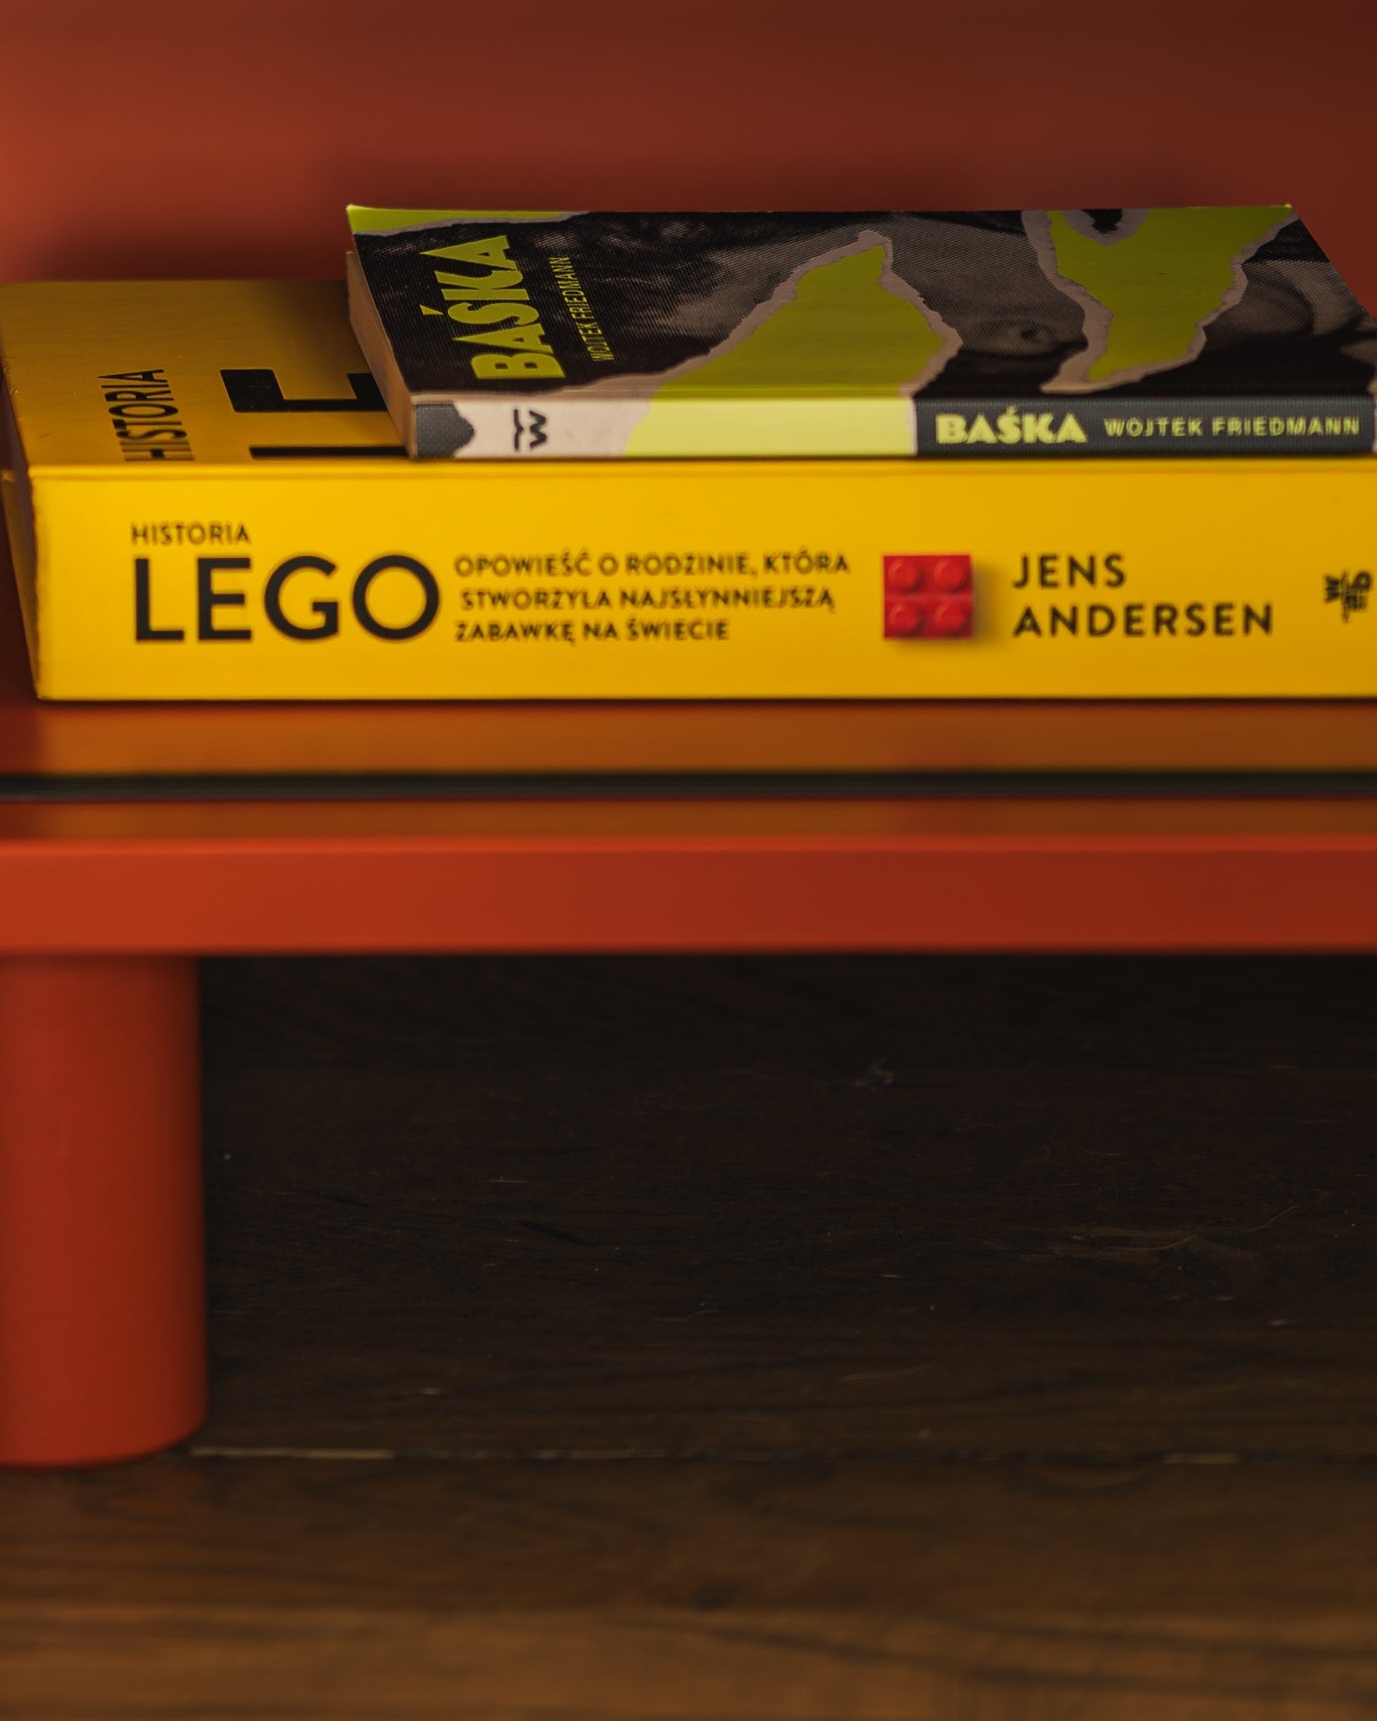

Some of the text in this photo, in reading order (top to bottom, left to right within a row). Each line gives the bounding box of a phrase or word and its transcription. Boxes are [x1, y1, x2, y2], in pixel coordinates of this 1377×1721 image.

[548, 255, 597, 321] FRIEDMANN
[419, 235, 566, 380] BAŚKA
[97, 368, 196, 462] HISTORIA
[935, 405, 1361, 446] BAŚKA WOJTEK FRIEDMANN
[130, 522, 251, 546] HISTORIA
[453, 545, 850, 579] OPOWIEŚĆ O RODZINIE, KTÓRA
[1012, 552, 1127, 590] JENS
[134, 554, 441, 642] LEGO
[459, 585, 837, 614] STWORZYŁA NAJSŁYNNIEJSZĄ
[454, 614, 731, 646] ZABAWKĘ NA ŚWIECIE
[1012, 602, 1274, 639] ANDERSEN
